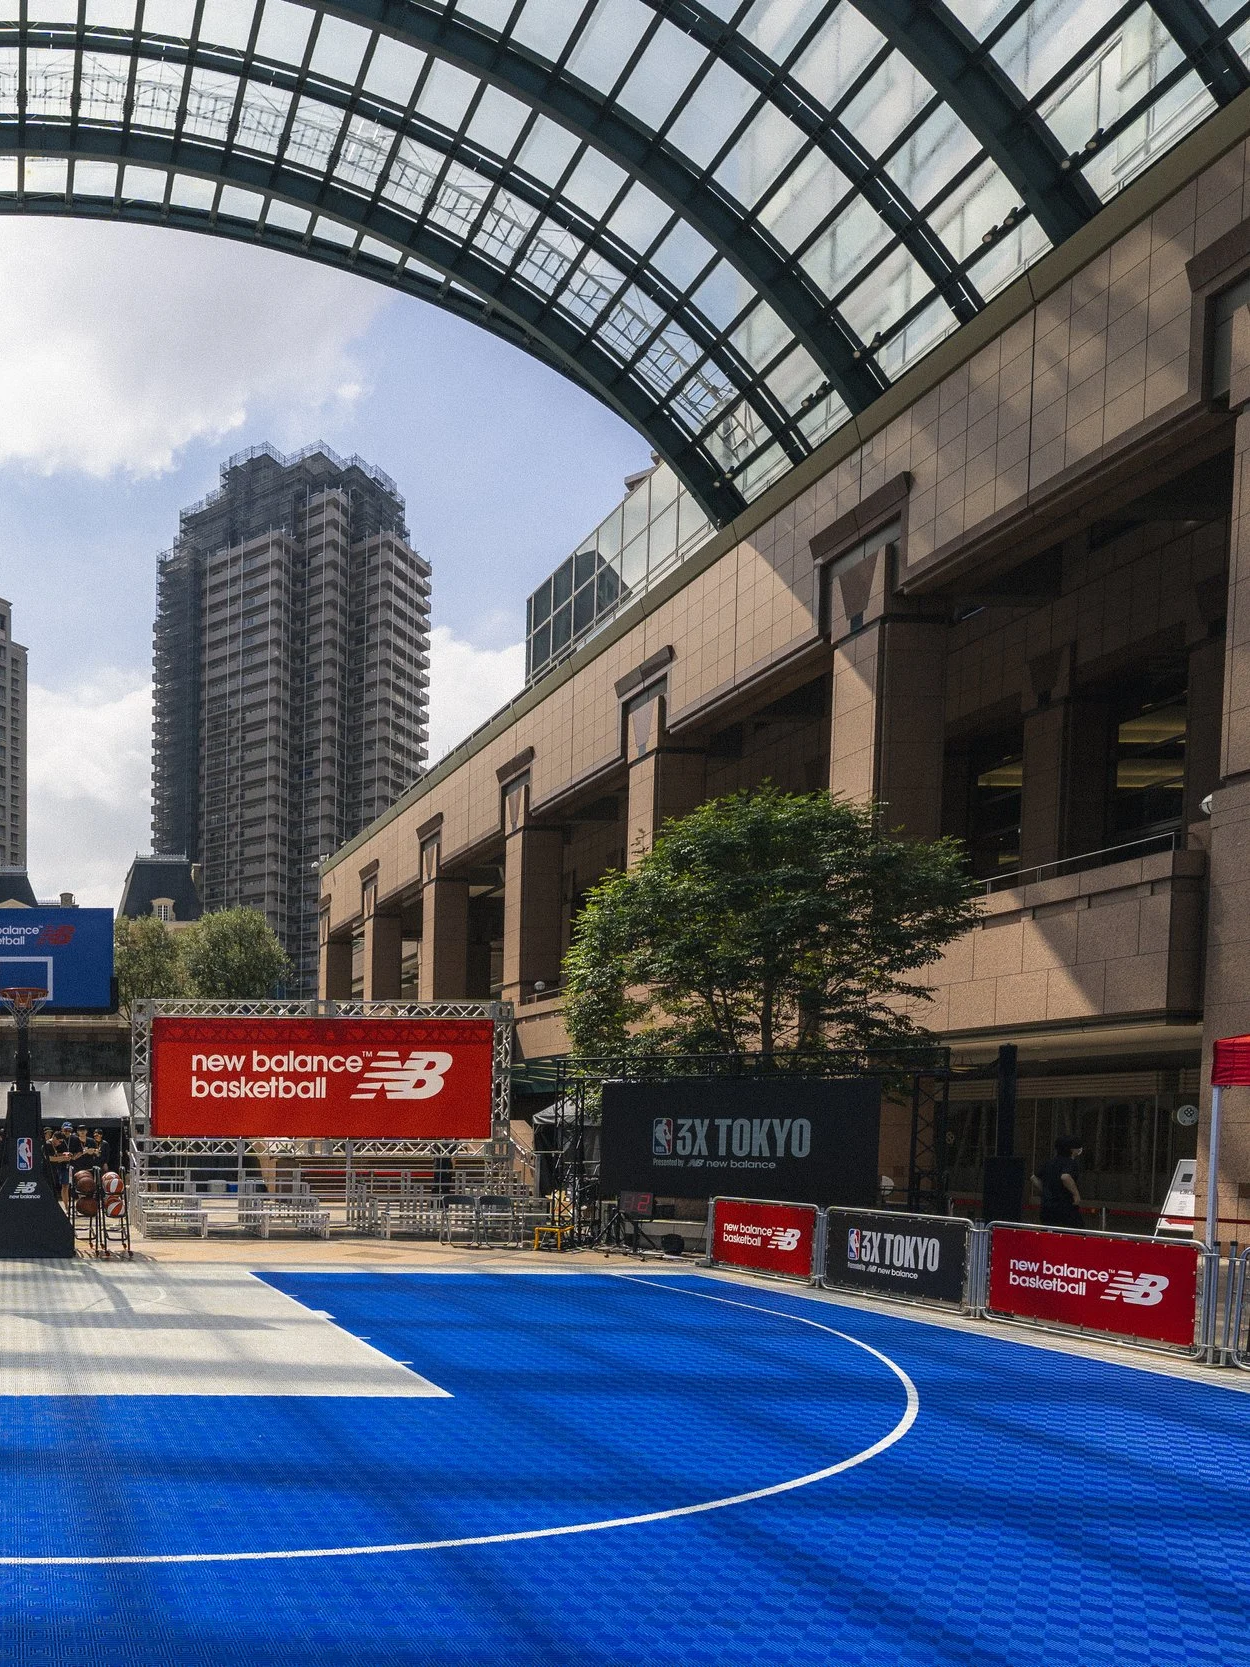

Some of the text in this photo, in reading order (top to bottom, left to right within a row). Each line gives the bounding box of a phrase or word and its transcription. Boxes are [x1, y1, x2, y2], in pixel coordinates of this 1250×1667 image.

[192, 1054, 246, 1072] new
[350, 1051, 453, 1099] NB
[192, 1076, 326, 1098] basketball
[676, 1118, 811, 1157] 3X TOKYO
[730, 1160, 776, 1169] balance
[724, 1223, 739, 1231] new
[723, 1232, 761, 1246] basketball
[861, 1231, 940, 1272] 3X TOKYO
[891, 1268, 918, 1279] balance
[1010, 1259, 1040, 1272] new
[1009, 1272, 1086, 1296] basketball
[1100, 1270, 1169, 1306] NB
